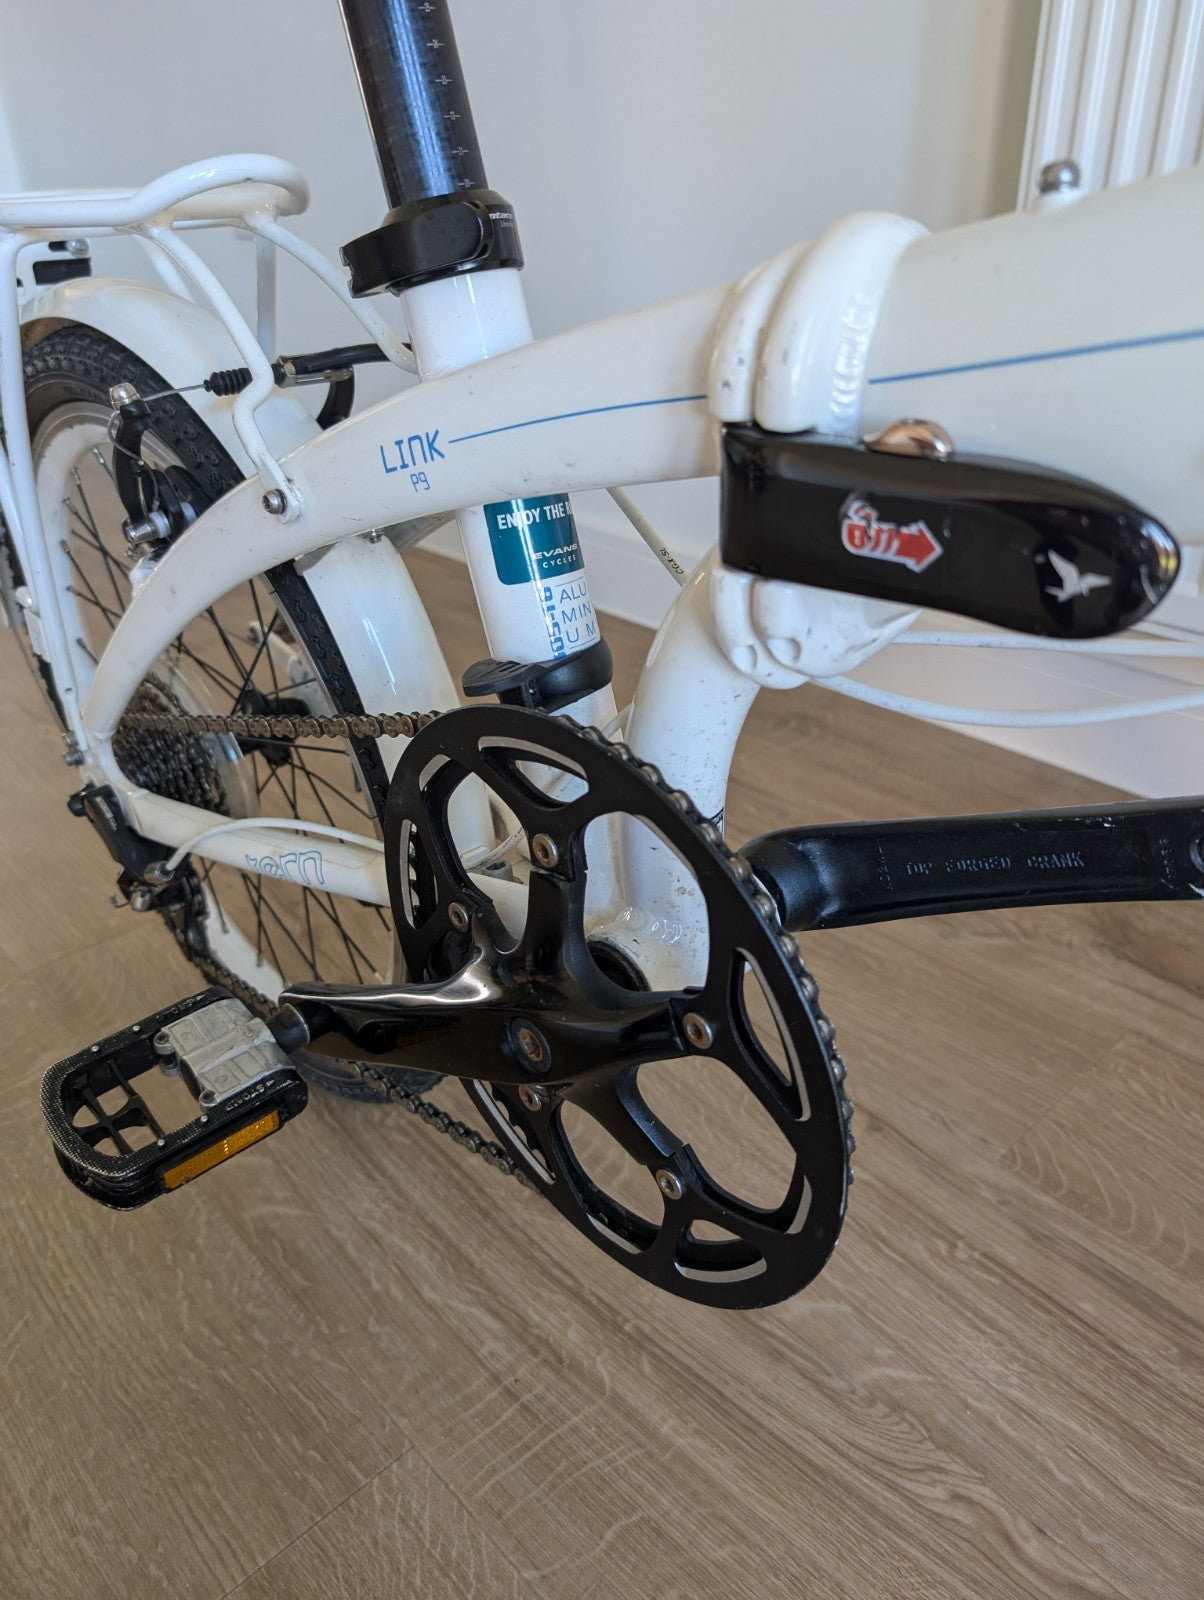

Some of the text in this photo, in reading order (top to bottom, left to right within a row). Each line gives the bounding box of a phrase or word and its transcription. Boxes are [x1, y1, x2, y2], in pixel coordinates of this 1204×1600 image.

[380, 429, 446, 474] LINK
[496, 507, 541, 530] ENJOY
[543, 503, 566, 520] THE
[531, 543, 578, 560] EVANS
[542, 554, 577, 568] CYCLES
[560, 580, 587, 604] ALU
[561, 601, 592, 624] MIN
[945, 856, 1011, 873] FORGED
[1027, 851, 1085, 871] CRANK
